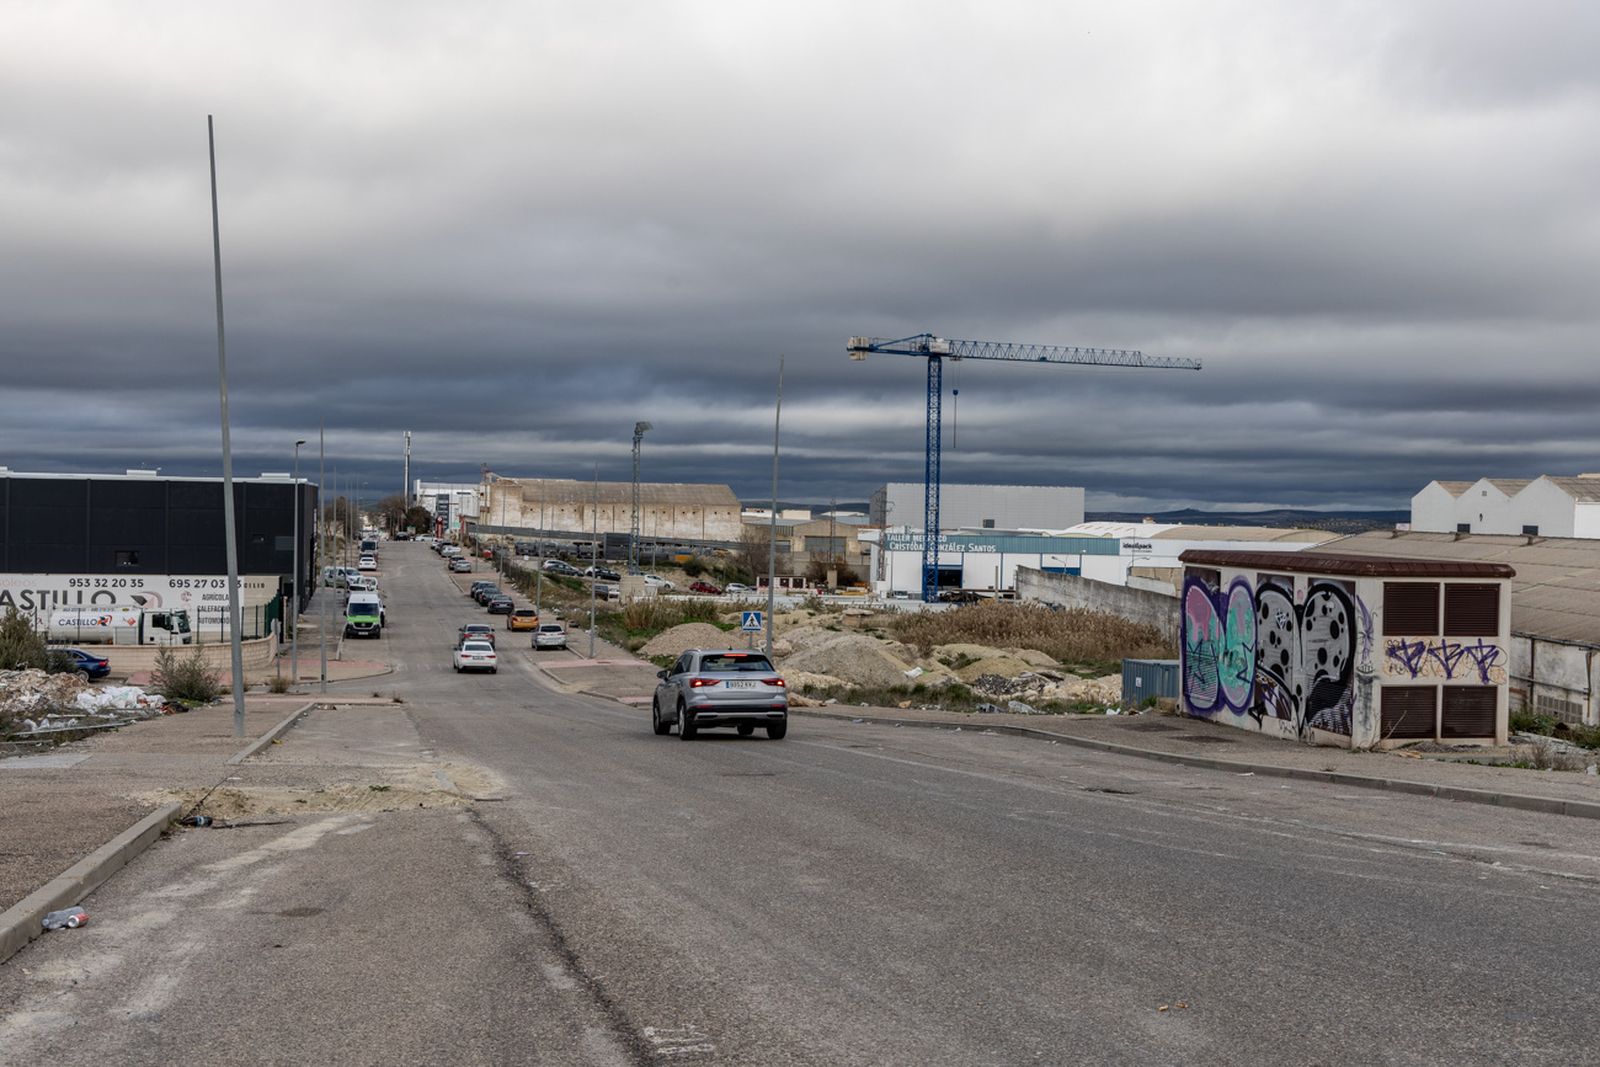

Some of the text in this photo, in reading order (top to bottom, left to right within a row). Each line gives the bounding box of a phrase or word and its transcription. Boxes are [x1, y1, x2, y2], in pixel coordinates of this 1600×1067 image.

[69, 578, 144, 588] 953 32 20 35
[169, 579, 191, 588] 695
[194, 579, 208, 588] 27
[210, 579, 225, 588] 03
